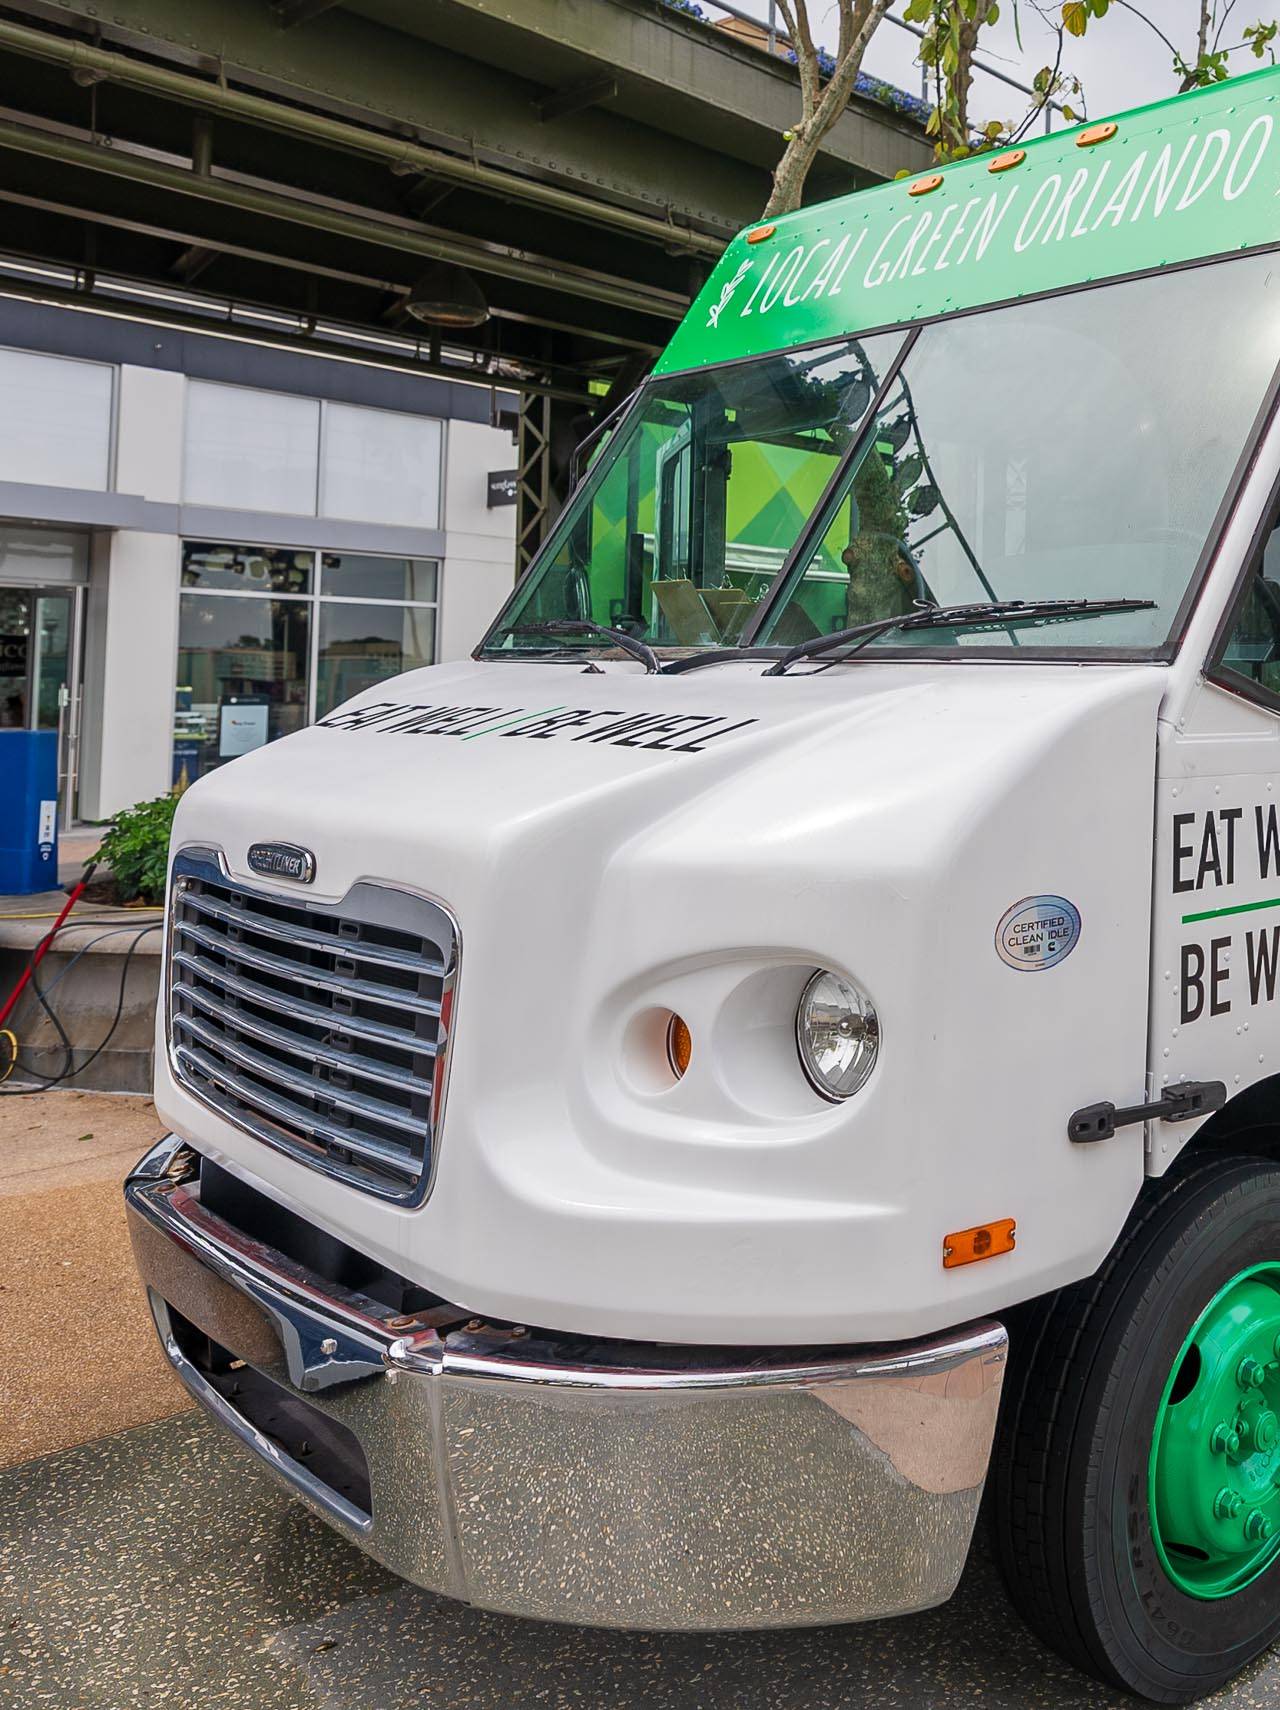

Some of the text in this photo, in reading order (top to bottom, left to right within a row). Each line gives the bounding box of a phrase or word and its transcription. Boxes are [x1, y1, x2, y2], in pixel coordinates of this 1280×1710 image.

[740, 115, 1274, 317] LOCAL GREEN ORLANDO
[316, 703, 760, 753] EAT WELL BE WELL
[1173, 808, 1242, 893] EAT
[1008, 927, 1070, 947] CLEAN IDLE
[1013, 917, 1065, 933] CERTIFIED
[1180, 935, 1231, 1025] BE
